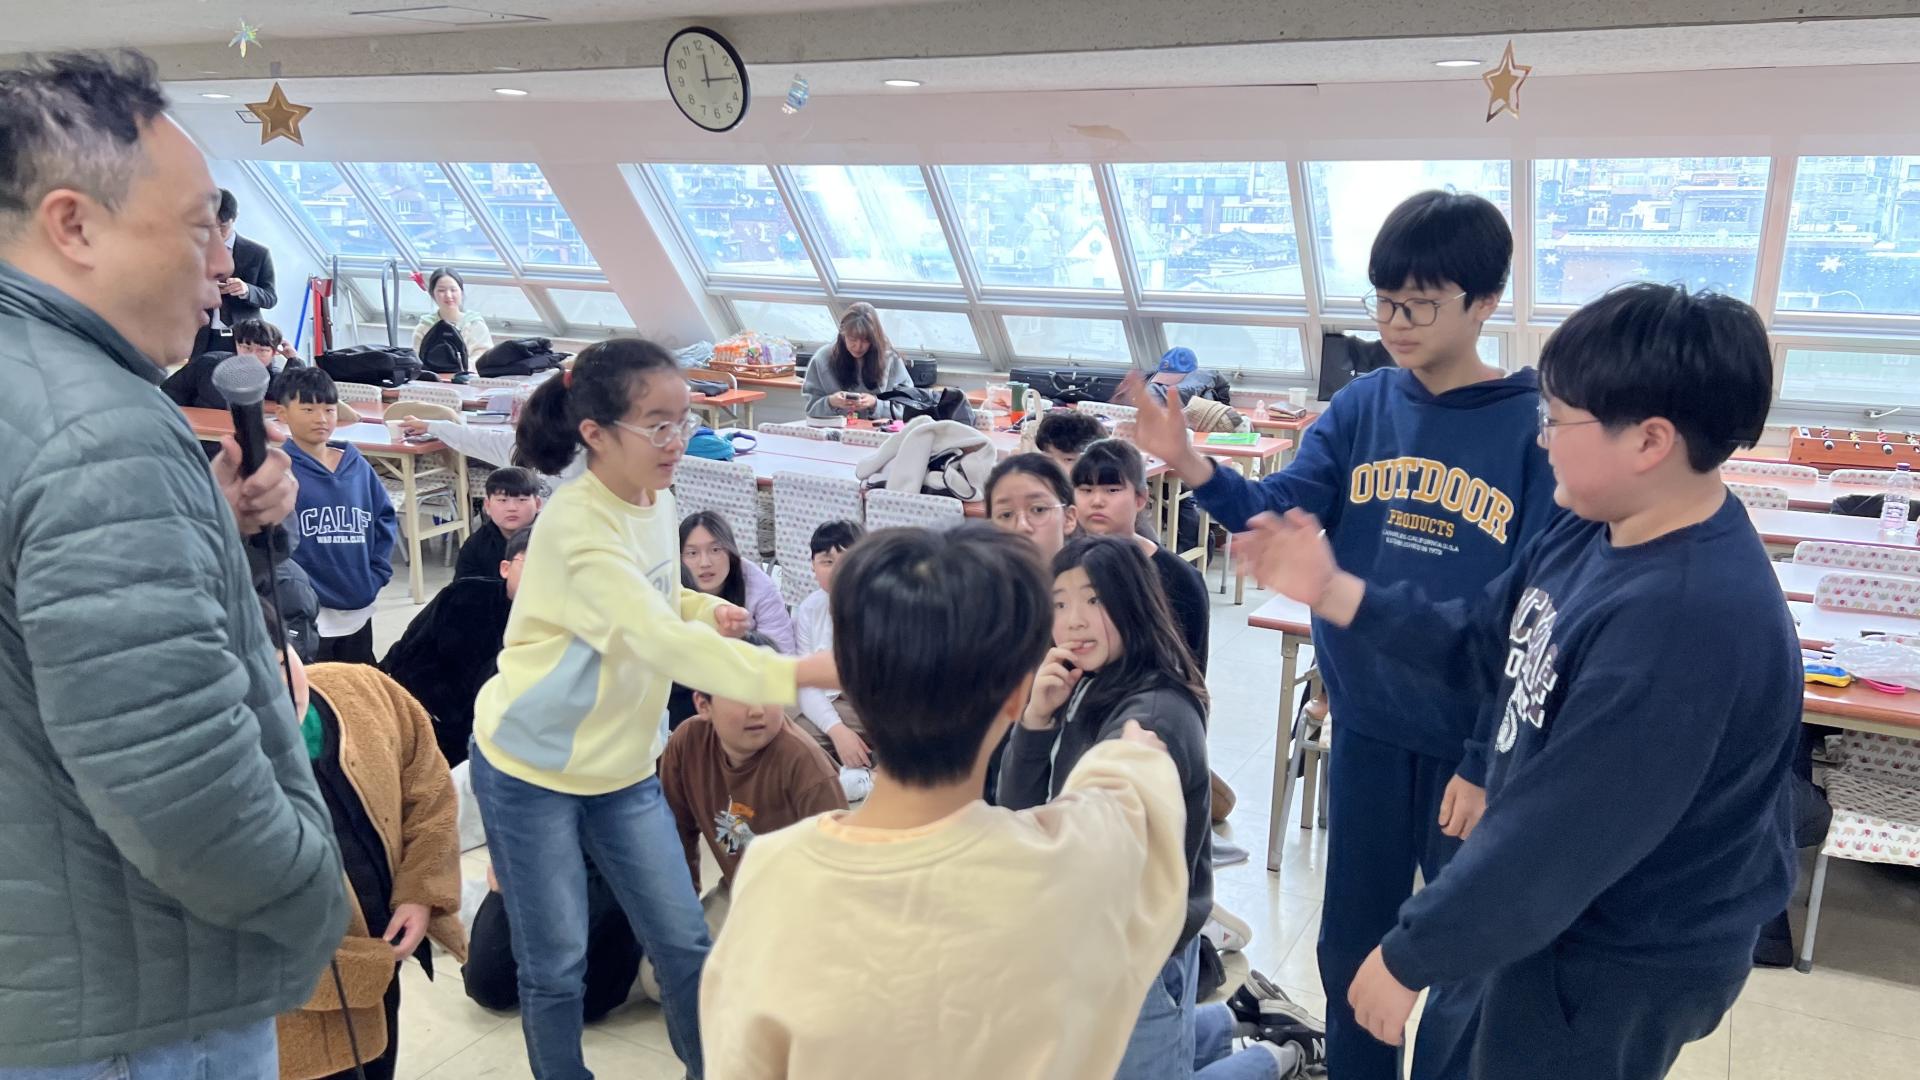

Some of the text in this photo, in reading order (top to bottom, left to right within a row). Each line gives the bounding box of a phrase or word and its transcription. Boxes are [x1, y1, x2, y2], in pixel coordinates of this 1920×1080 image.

[682, 45, 691, 56] 11
[693, 40, 703, 51] 12
[710, 44, 716, 55] 1
[676, 59, 687, 70] 10
[722, 55, 731, 67] 2
[678, 76, 685, 87] 9
[731, 73, 739, 84] 3
[688, 93, 695, 105] 8
[732, 91, 739, 102] 4
[701, 105, 706, 116] 7
[714, 108, 721, 119] 6
[726, 103, 733, 114] 5
[1350, 456, 1514, 544] OUTDOOR
[301, 506, 371, 536] CALIF
[1387, 509, 1455, 538] PRODUCTS
[1312, 1038, 1326, 1060] N
